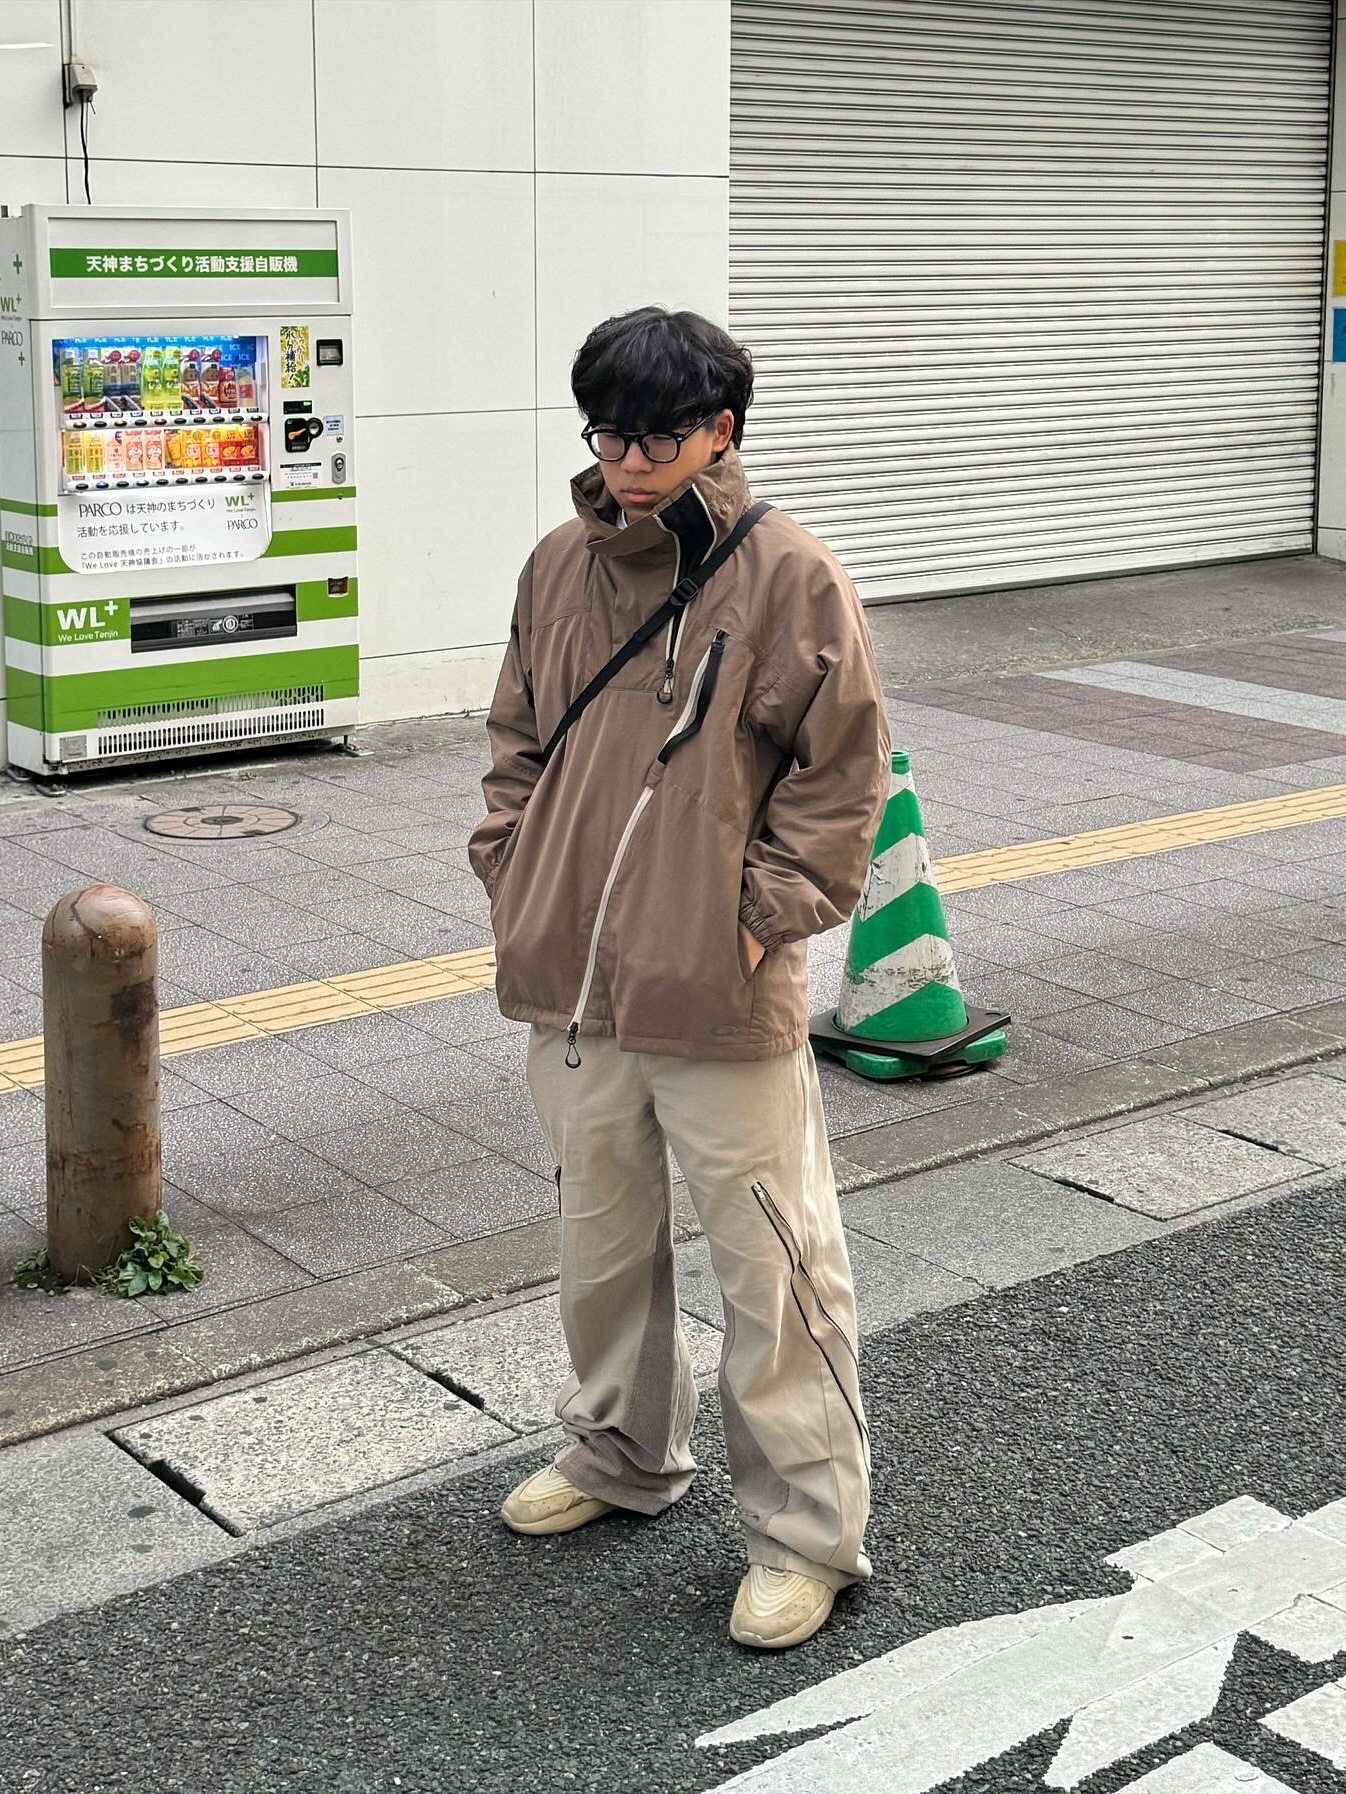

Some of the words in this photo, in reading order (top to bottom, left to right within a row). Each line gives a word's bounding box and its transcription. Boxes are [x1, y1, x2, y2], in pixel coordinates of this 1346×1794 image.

[86, 255, 298, 273] 天神まちづくり活動支援自販機
[229, 343, 241, 351] ICE
[238, 353, 250, 361] ICE
[79, 502, 122, 518] PARCO
[126, 498, 216, 515] は天神のまちづくり
[77, 521, 185, 539] 活動を応援しています。
[226, 518, 258, 531] PARCO
[58, 633, 72, 642] We
[74, 632, 93, 641] Love
[95, 630, 118, 641] Tenjin
